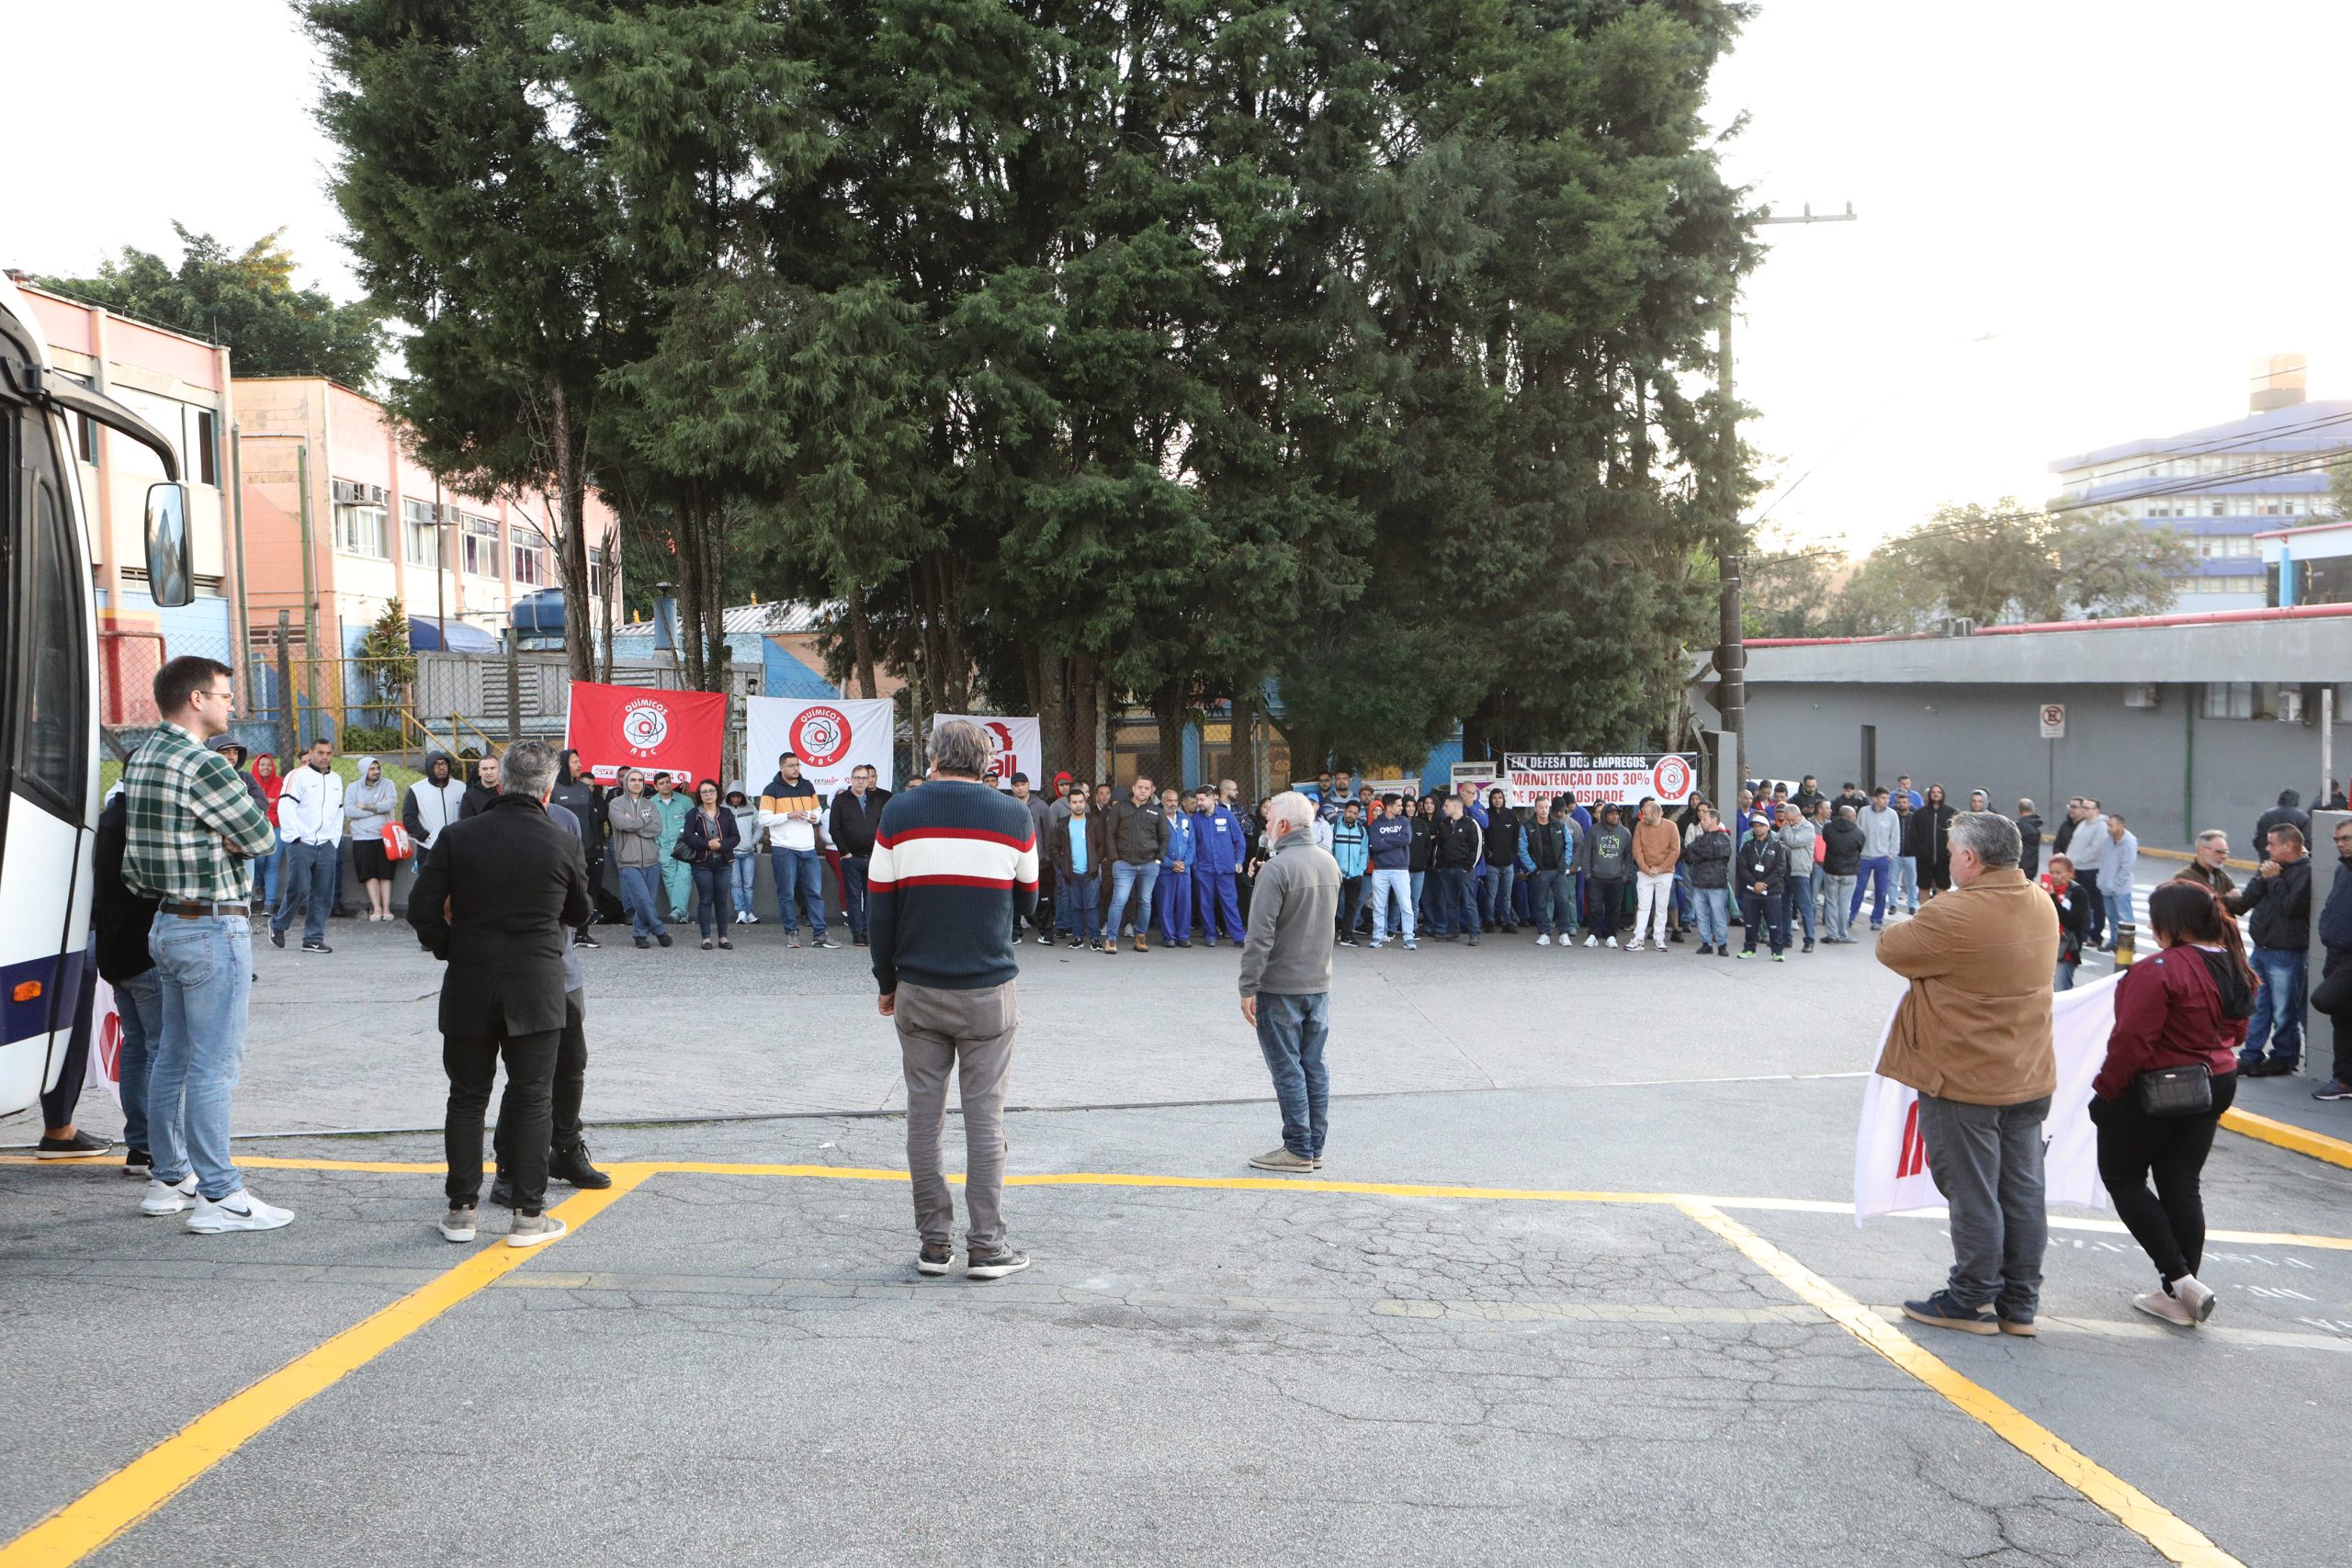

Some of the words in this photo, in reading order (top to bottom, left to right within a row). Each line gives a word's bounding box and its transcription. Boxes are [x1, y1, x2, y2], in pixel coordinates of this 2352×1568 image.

[625, 698, 669, 716] QUÍMICOS
[800, 707, 842, 724] QUÍMICOS
[1510, 756, 1527, 769] EM
[1530, 756, 1566, 769] DEFESA
[1569, 756, 1590, 769] DOS
[1592, 756, 1649, 770] EMPREGOS,
[1511, 770, 1592, 789] MANUTENÇÃO
[1596, 773, 1619, 785] DOS
[1623, 773, 1650, 785] 30%
